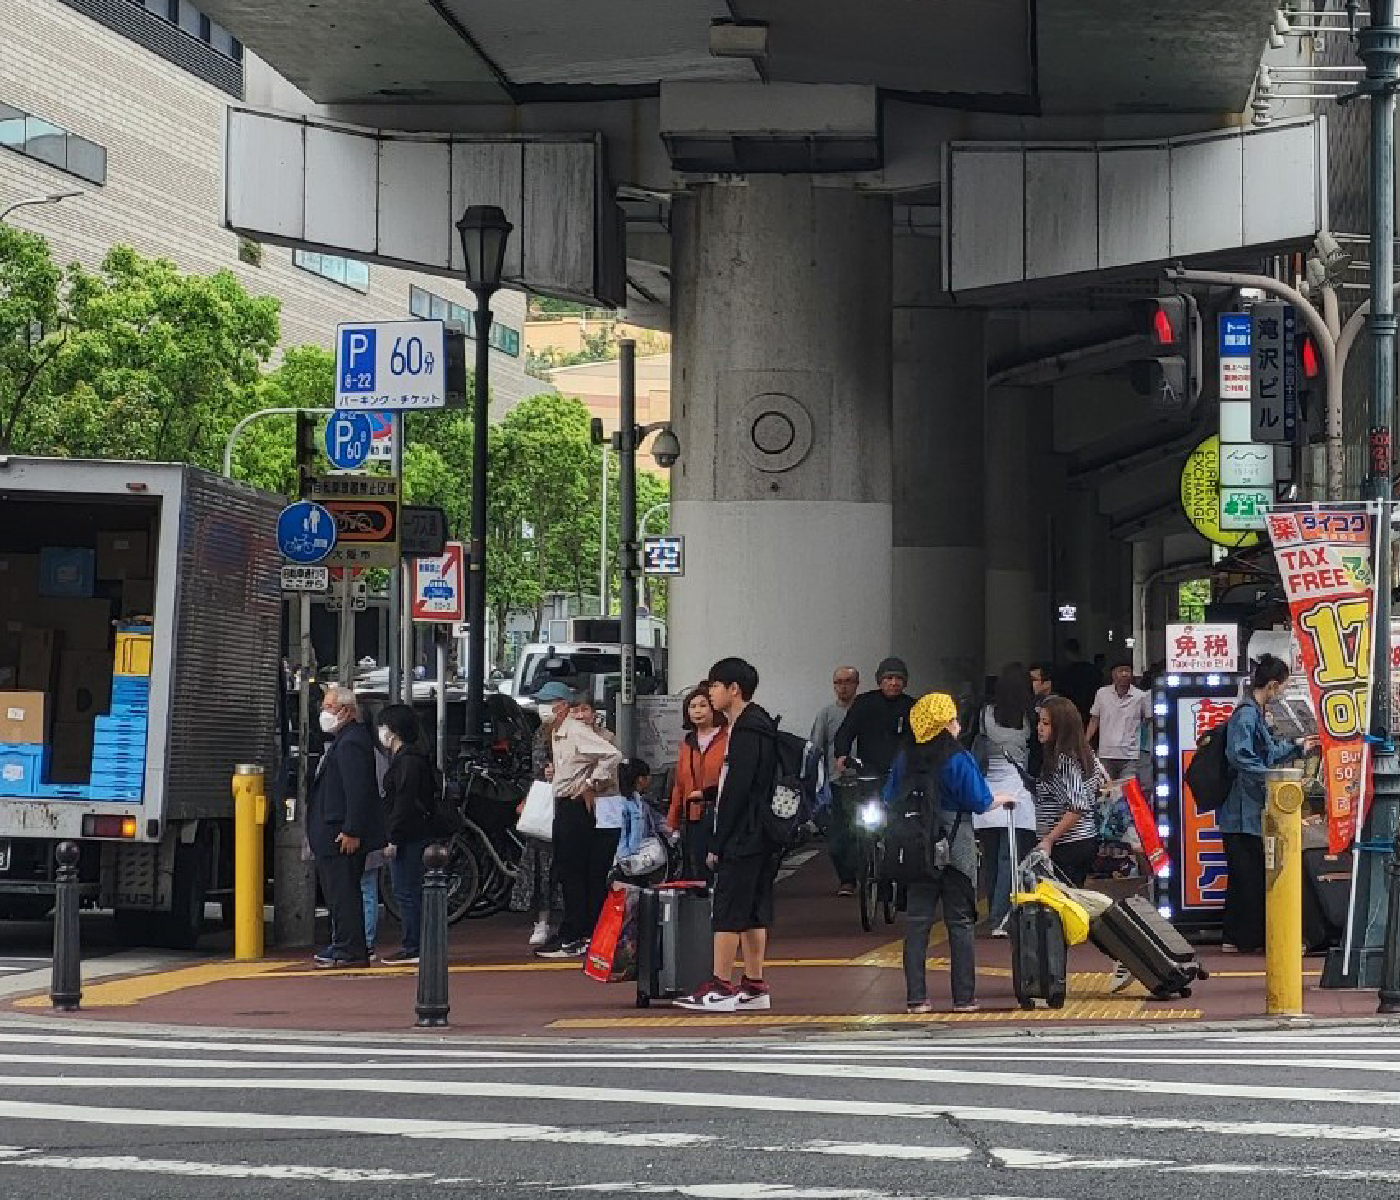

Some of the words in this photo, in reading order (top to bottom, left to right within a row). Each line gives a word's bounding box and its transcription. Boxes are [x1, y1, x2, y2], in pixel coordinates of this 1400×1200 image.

[350, 334, 368, 368] P
[335, 420, 353, 460] P
[1193, 451, 1205, 525] EXCHANGE
[1205, 451, 1218, 525] CURRENCY
[645, 538, 679, 574] 空
[1281, 547, 1329, 570] TAX
[1288, 568, 1349, 594] FREE
[1175, 634, 1229, 659] 免税
